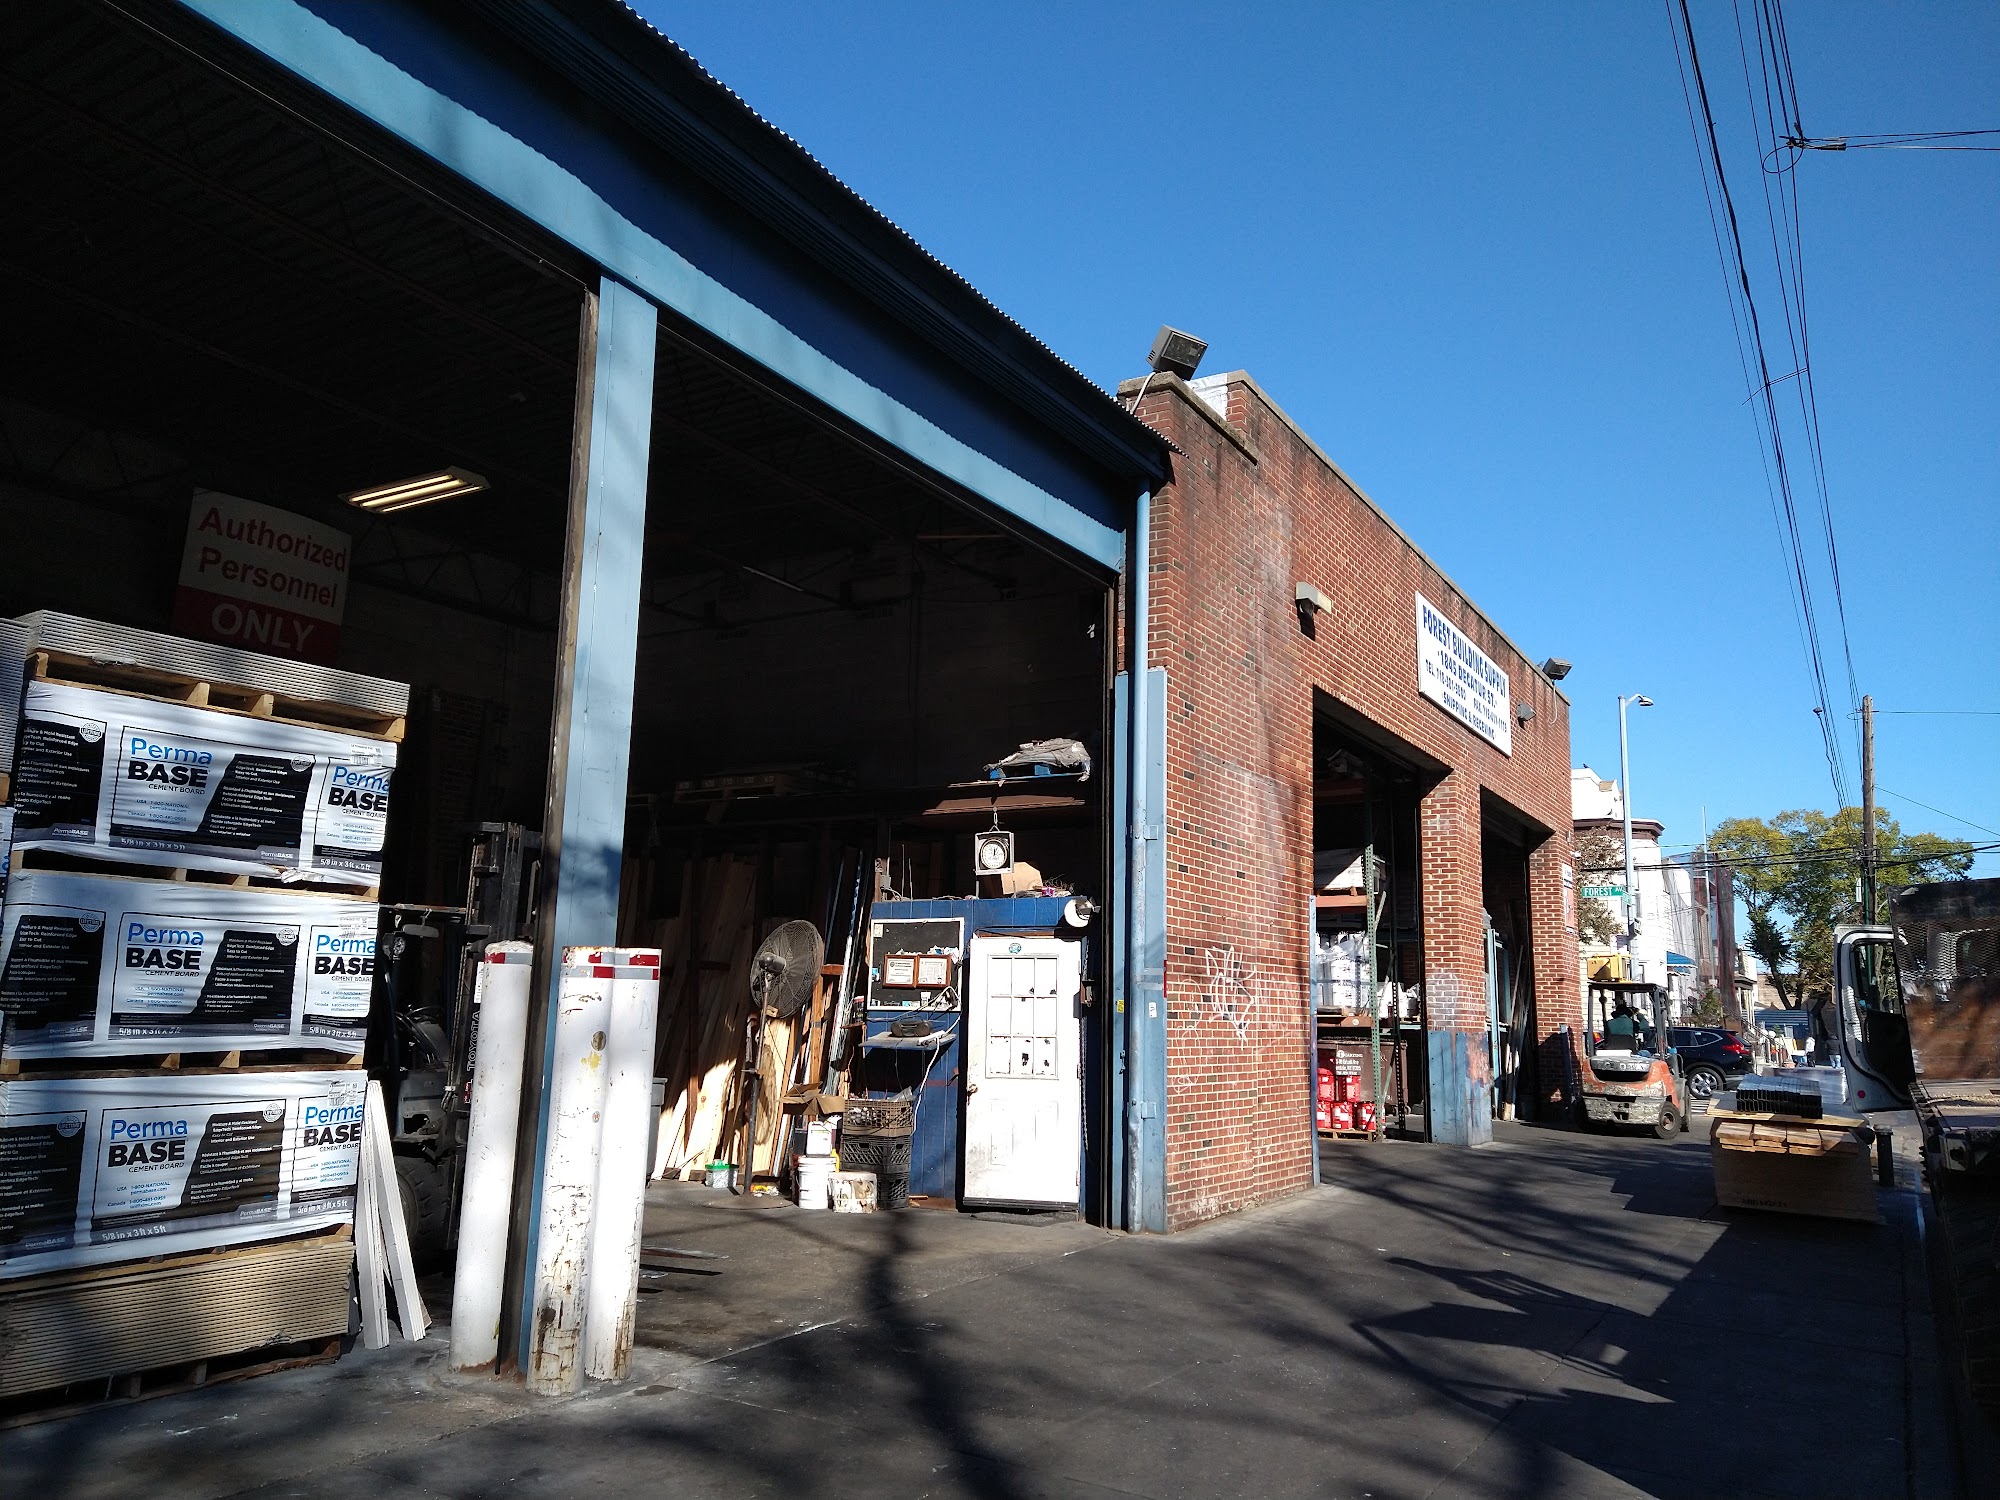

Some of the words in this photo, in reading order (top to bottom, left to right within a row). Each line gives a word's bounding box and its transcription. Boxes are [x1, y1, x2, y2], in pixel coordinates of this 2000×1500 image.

[198, 506, 347, 572] Authorized
[198, 546, 338, 608] Personnel
[211, 603, 315, 652] ONLY
[1423, 604, 1451, 650] FOREST
[1452, 631, 1484, 679] BUILDING
[1484, 660, 1506, 698] SUPPLY
[1440, 650, 1457, 676] 1845
[1458, 664, 1486, 701] DECATUR
[1443, 691, 1468, 720] SHIPPING
[131, 737, 213, 765] Perma
[128, 760, 208, 788] BASE
[333, 766, 389, 792] Perma
[148, 783, 179, 792] CEMENT
[180, 787, 205, 795] BOARD
[328, 787, 387, 812] BASE
[342, 808, 365, 816] CEMENT
[1584, 887, 1612, 896] FOREST
[128, 923, 204, 946] Perma
[316, 934, 377, 953] Perma
[126, 947, 202, 970] BASE
[314, 957, 375, 975] BASE
[119, 1028, 132, 1036] 5/8
[467, 1010, 481, 1073] TOYOTA
[305, 1104, 364, 1124] Perma
[110, 1119, 188, 1140] Perma
[304, 1123, 360, 1146] BASE
[108, 1140, 185, 1168] BASE
[128, 1165, 158, 1173] CEMENT
[102, 1232, 116, 1241] 5/8
